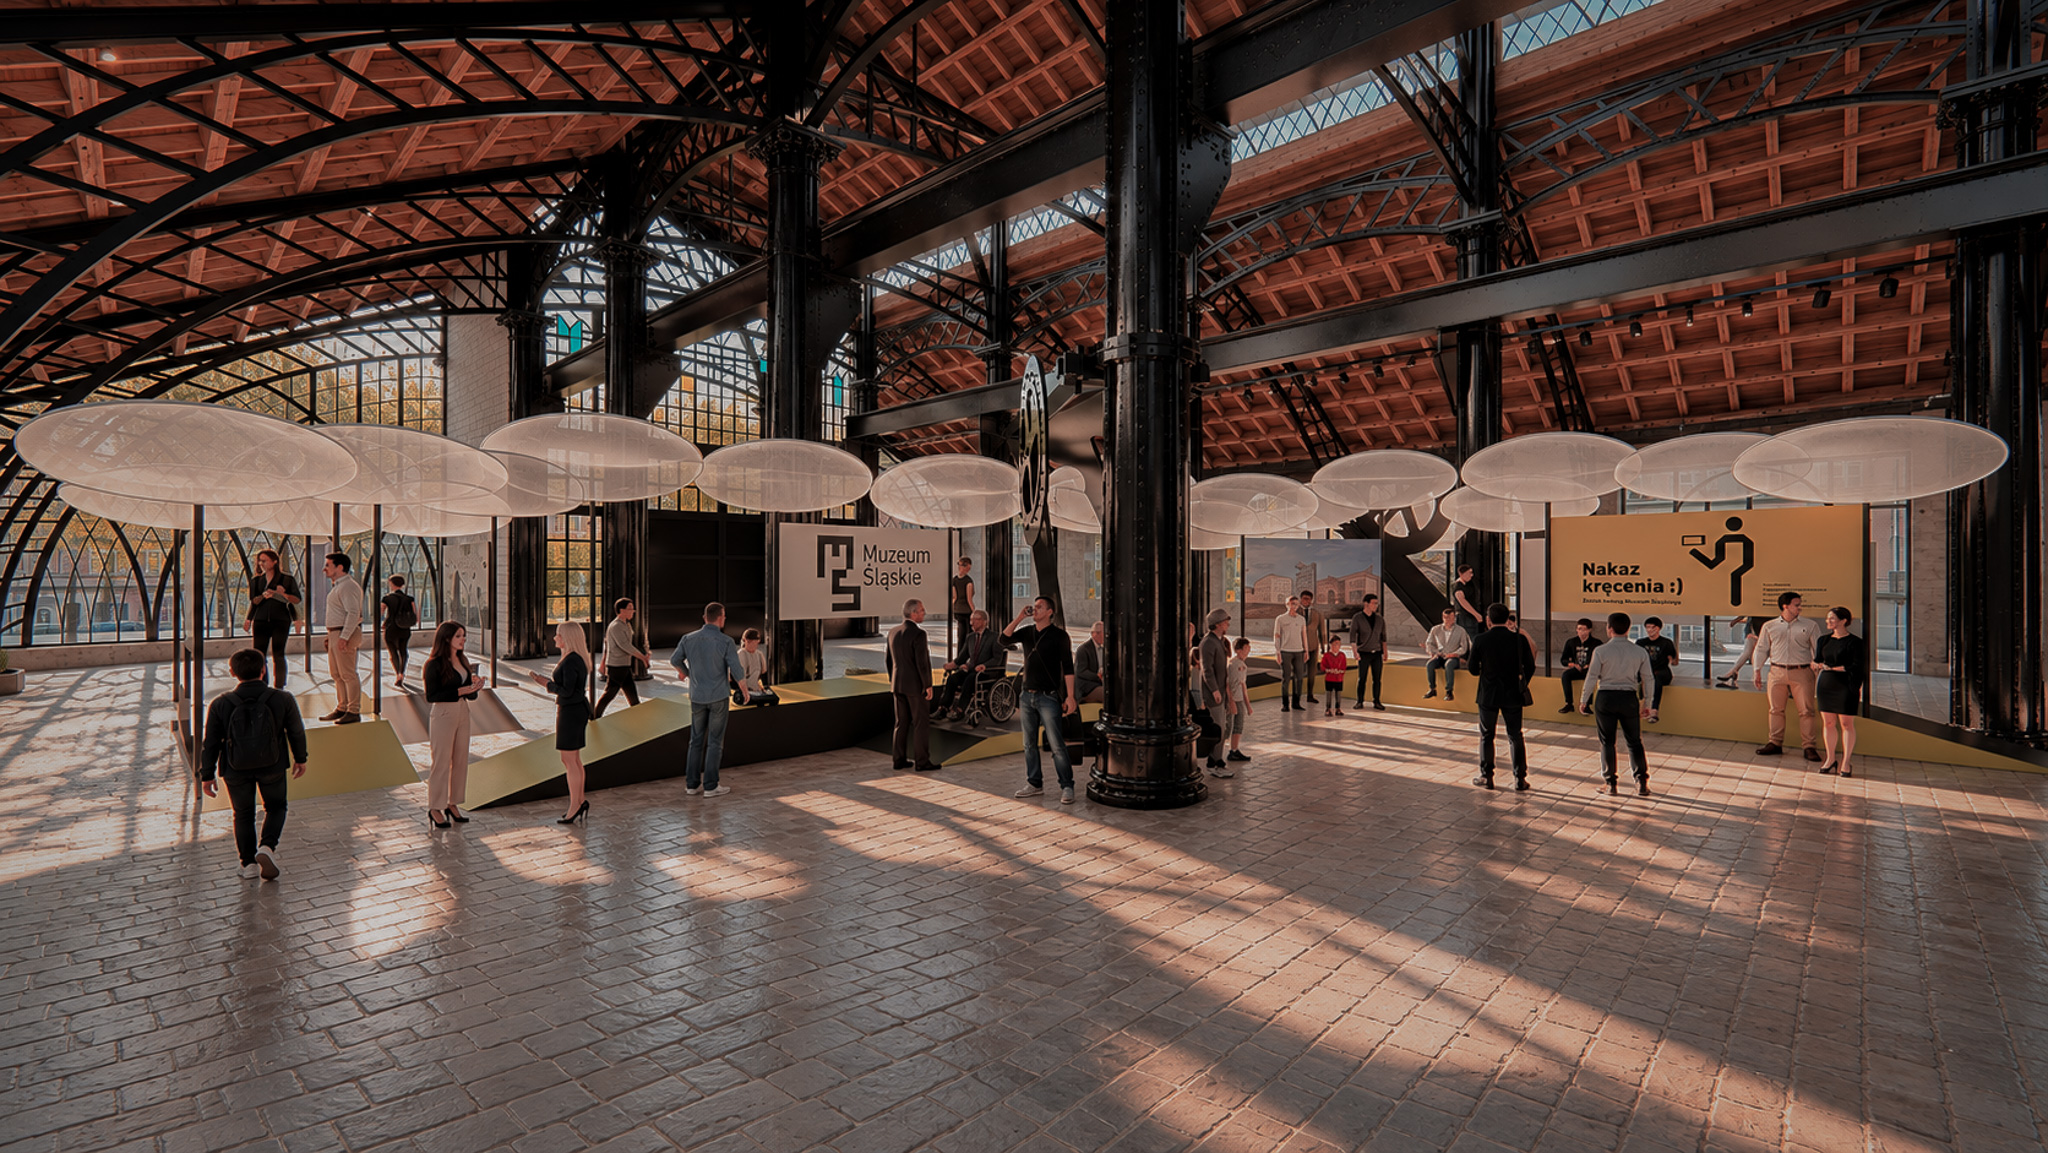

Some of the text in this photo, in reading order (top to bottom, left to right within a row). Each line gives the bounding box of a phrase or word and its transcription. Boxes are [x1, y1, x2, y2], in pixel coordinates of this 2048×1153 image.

[863, 544, 931, 563] Muzeum
[863, 563, 922, 591] Śląskie
[1583, 562, 1640, 576] Nakaz
[1583, 579, 1664, 597] kręcenia
